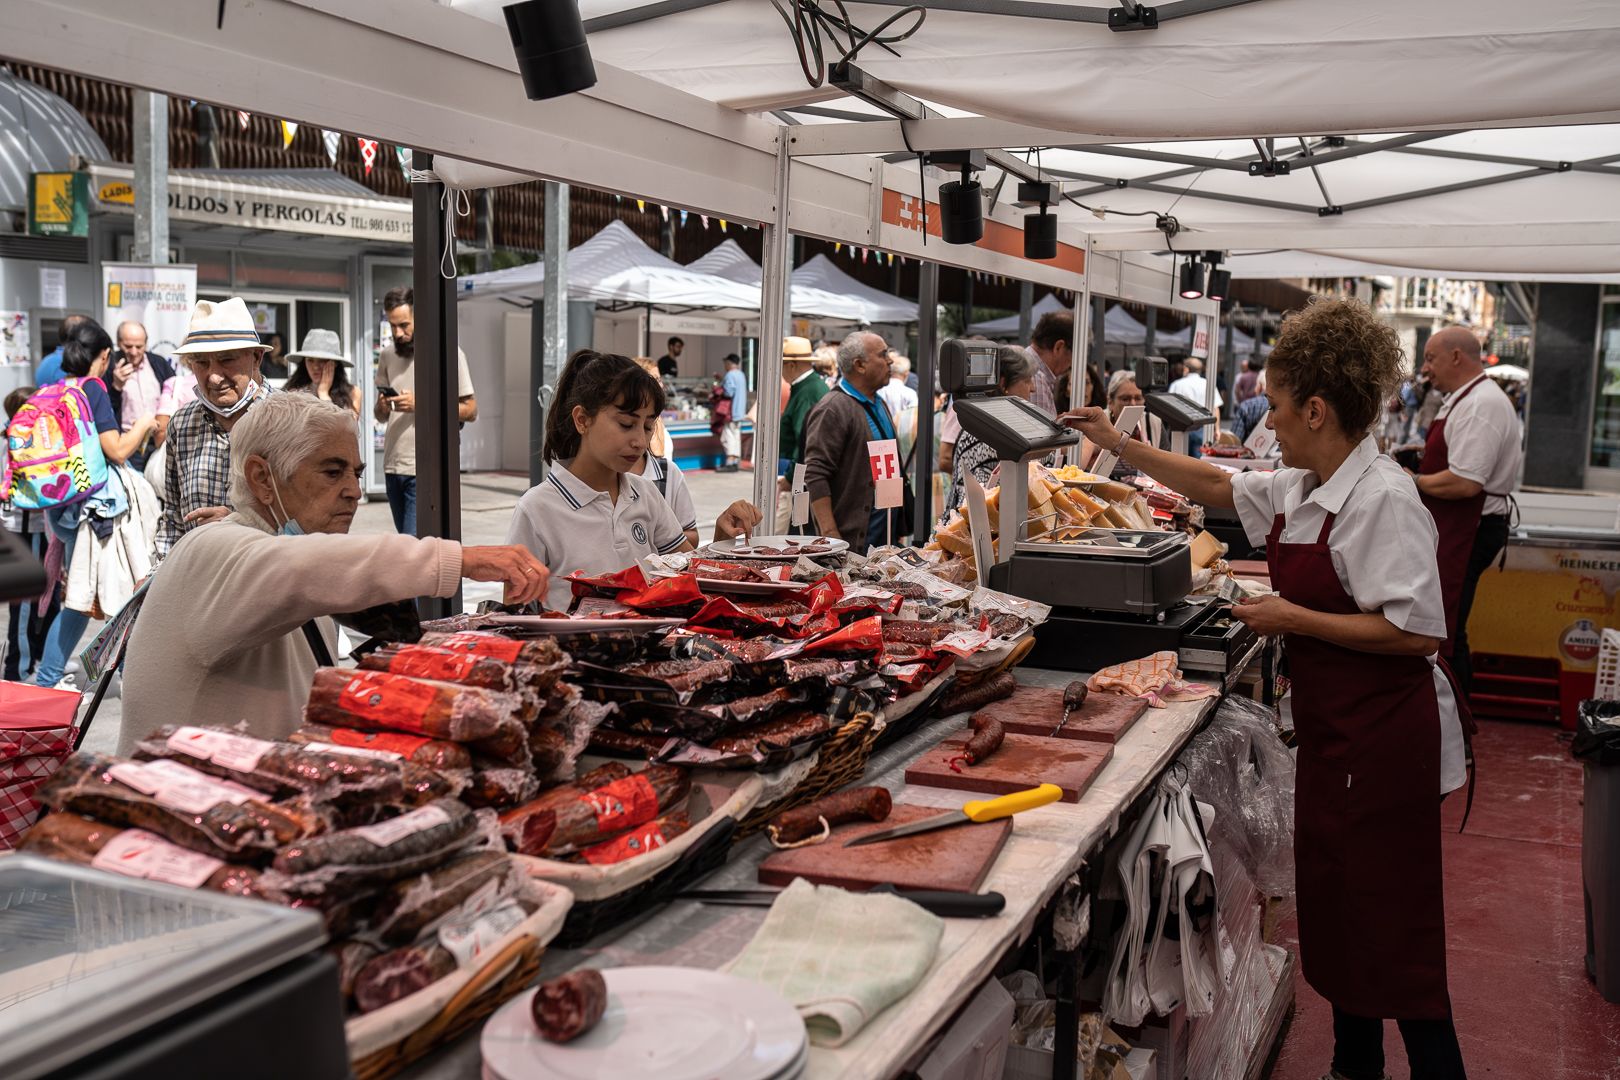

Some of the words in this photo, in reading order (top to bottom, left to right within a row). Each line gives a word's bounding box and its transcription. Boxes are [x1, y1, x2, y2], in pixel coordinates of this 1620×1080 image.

[234, 199, 246, 215] Y
[252, 201, 347, 227] PERGOLAS
[351, 216, 367, 229] TEL:
[124, 290, 162, 301] GUARDIA
[165, 292, 187, 302] CIVIL
[156, 303, 187, 311] ZAMORA
